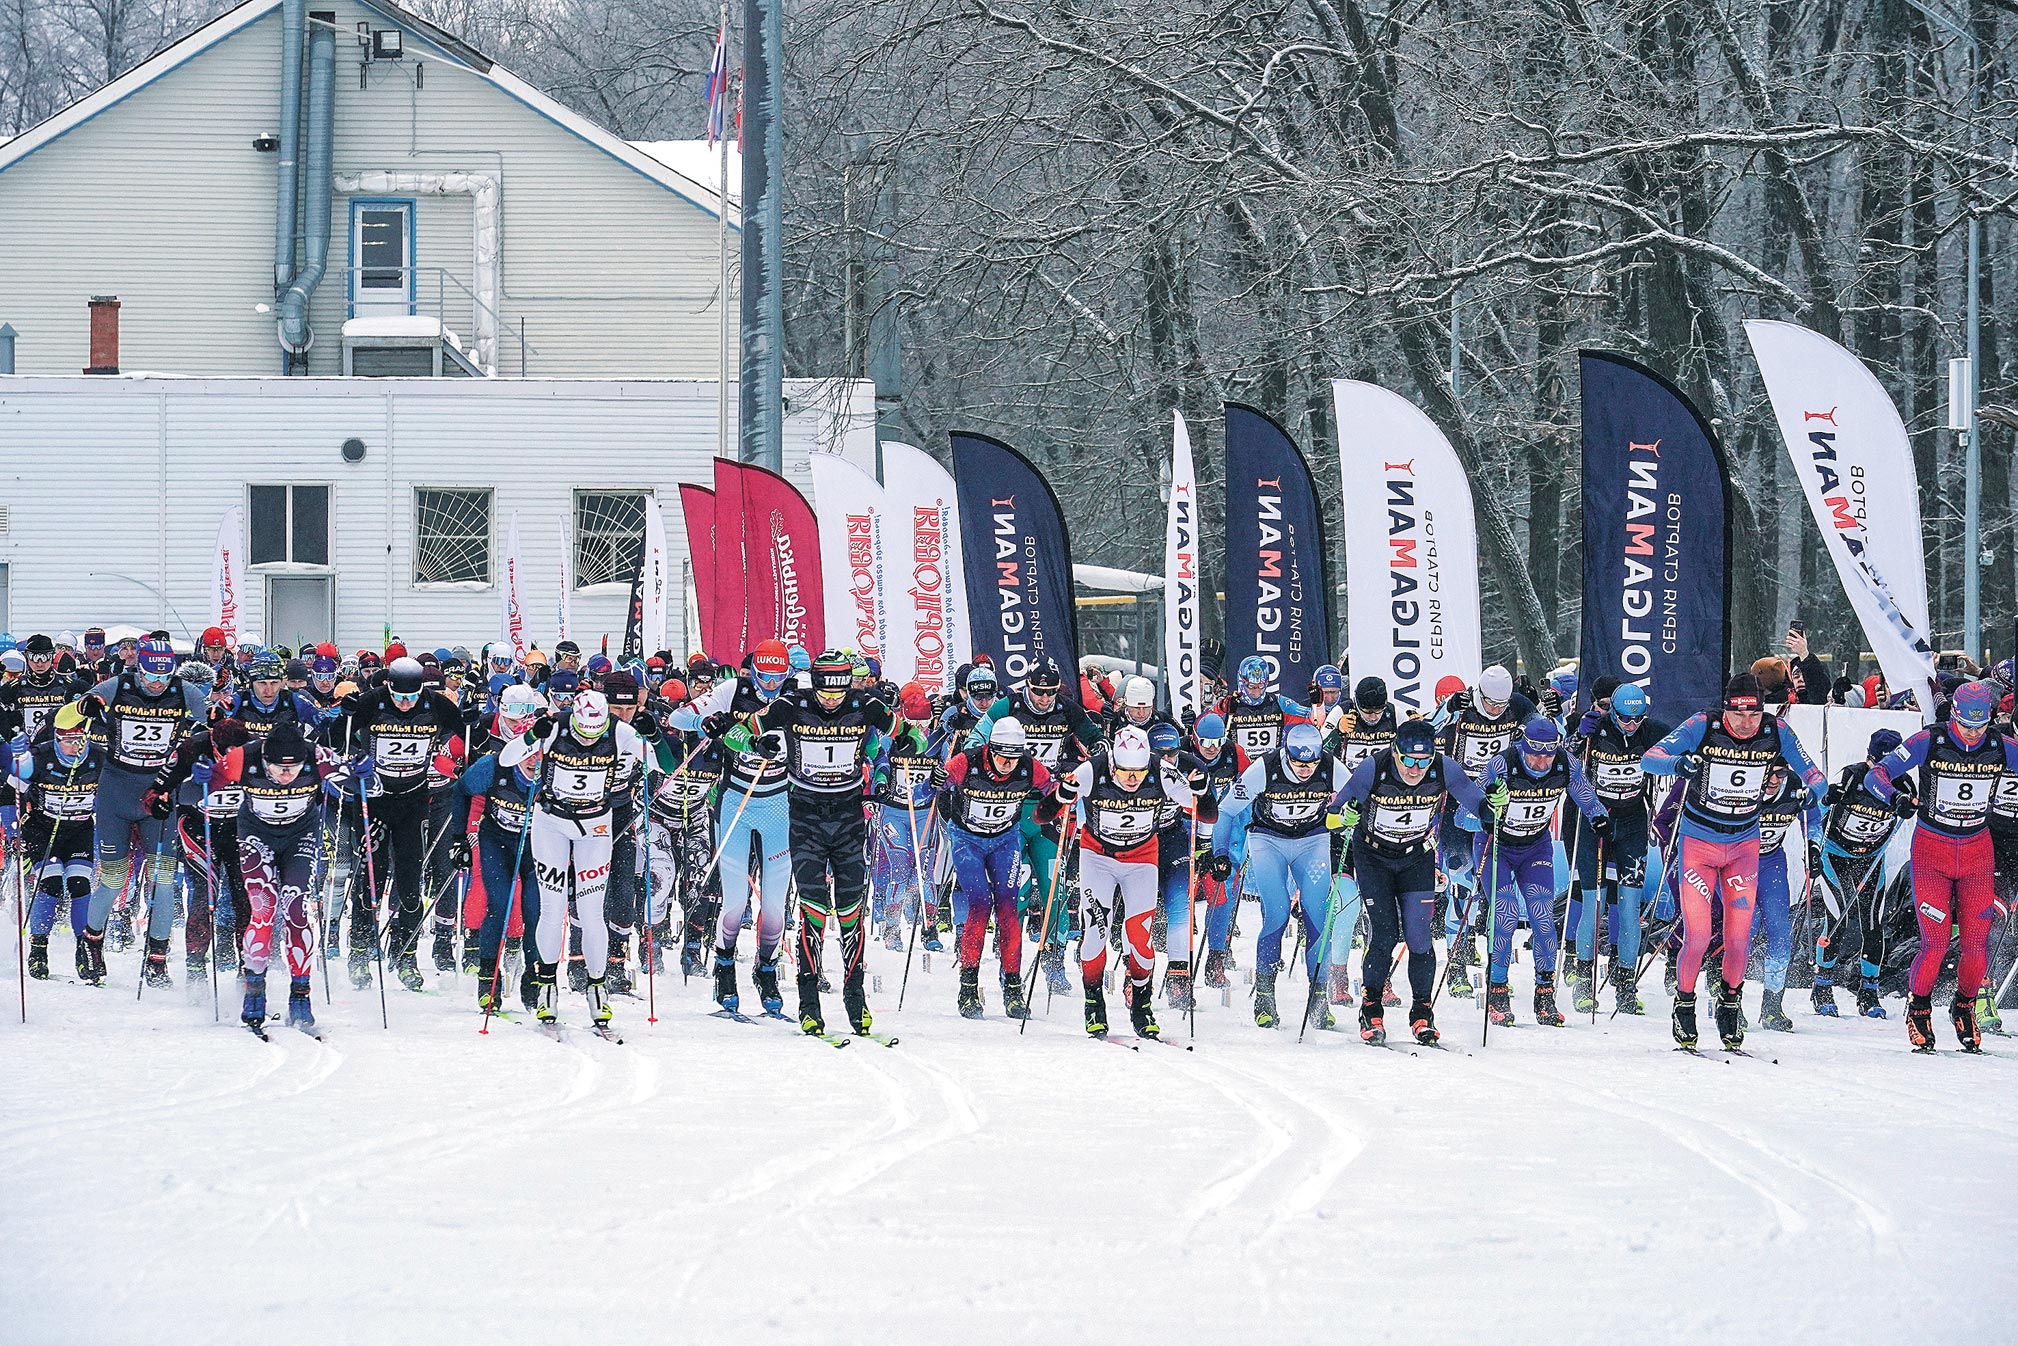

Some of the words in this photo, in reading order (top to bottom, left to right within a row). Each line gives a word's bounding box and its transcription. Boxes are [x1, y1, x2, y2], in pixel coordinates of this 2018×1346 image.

[756, 656, 786, 665] LUKOIL
[133, 725, 162, 741] 23
[1247, 731, 1270, 747] 59
[388, 742, 418, 755] 24
[824, 746, 834, 763] 1
[1026, 742, 1053, 757] 37
[1476, 740, 1501, 757] 39
[1795, 739, 1813, 765] LUKOIL
[572, 775, 588, 790] 3
[1730, 770, 1746, 787] 6
[1958, 783, 1973, 800] 8
[214, 794, 240, 804] 13
[274, 802, 288, 813] 5
[983, 806, 1007, 818] 16
[1286, 805, 1311, 815] 17
[1523, 806, 1546, 819] 18
[1850, 804, 1883, 818] ОКОЛЬИ
[1120, 815, 1135, 828] 2
[1395, 812, 1412, 825] 4
